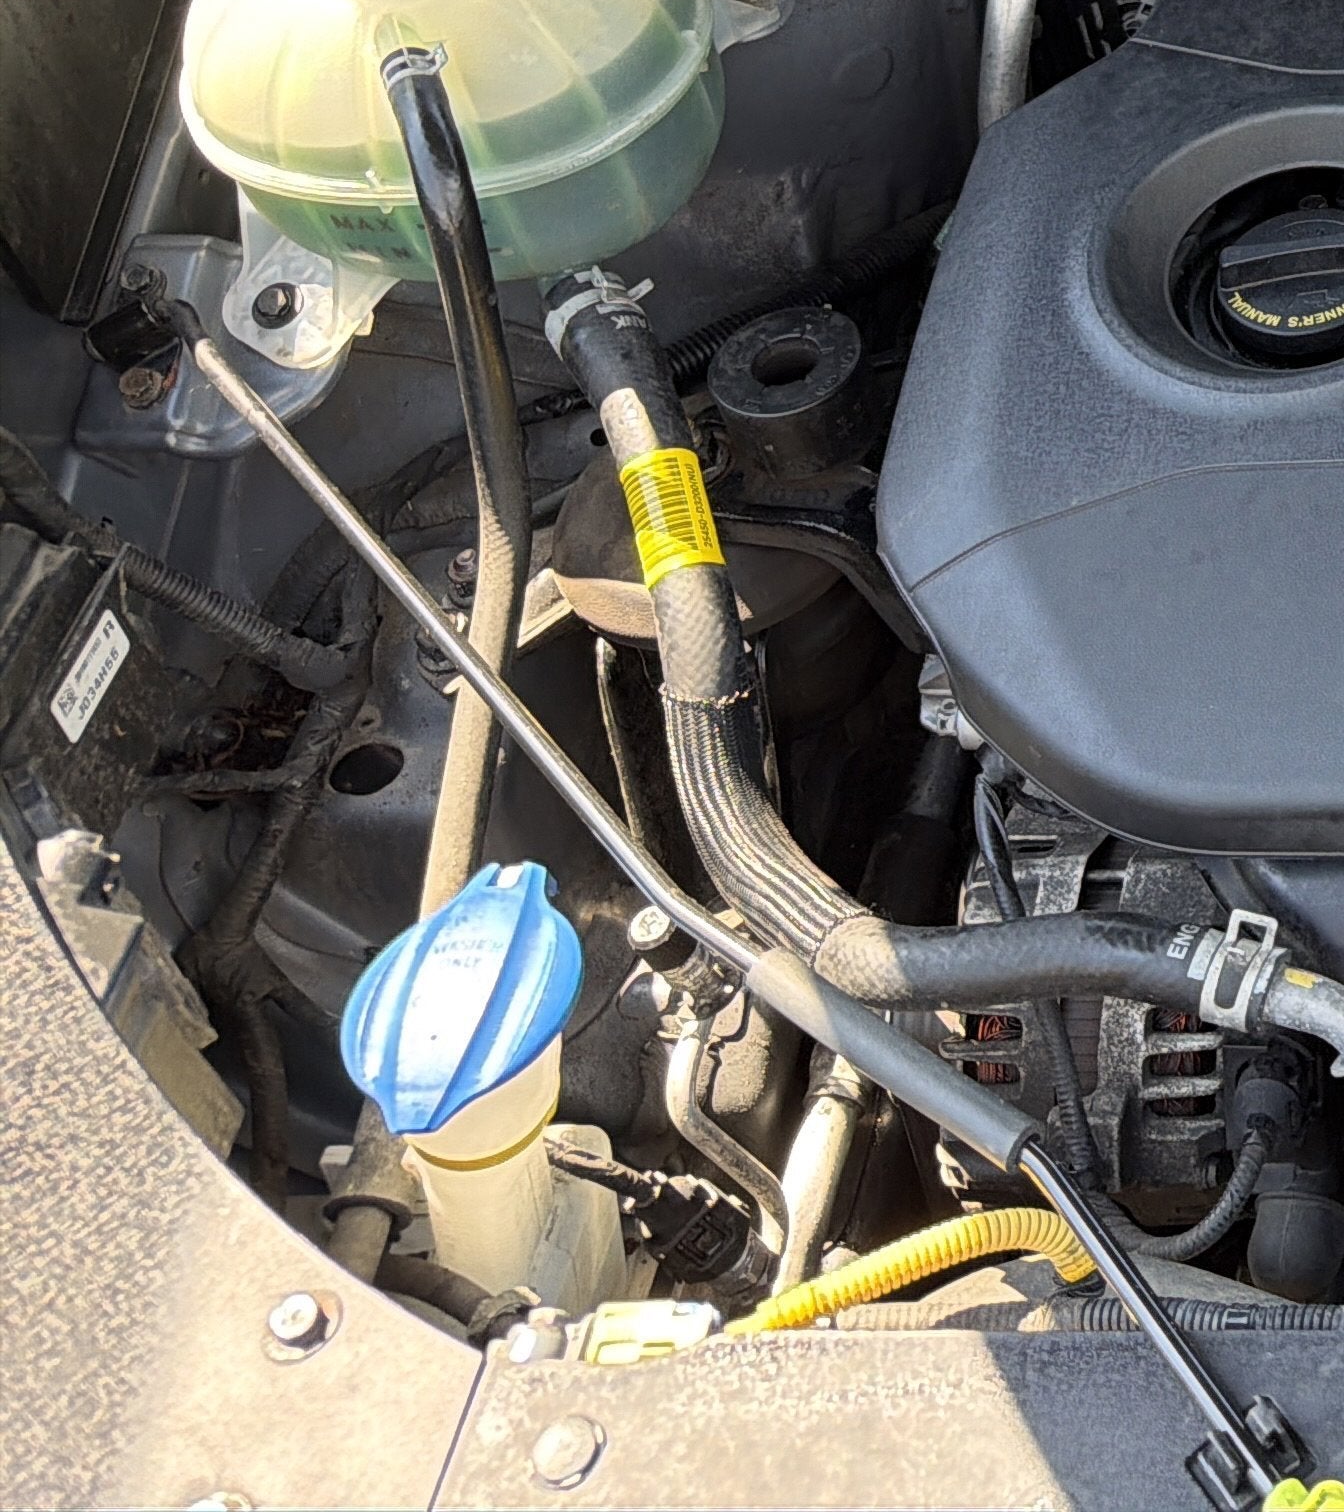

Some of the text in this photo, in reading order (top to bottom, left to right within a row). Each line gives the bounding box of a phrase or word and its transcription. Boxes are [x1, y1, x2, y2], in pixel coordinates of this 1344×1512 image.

[329, 214, 396, 232] MAX
[1227, 291, 1282, 327] MANUAL
[1166, 924, 1201, 960] ENG
